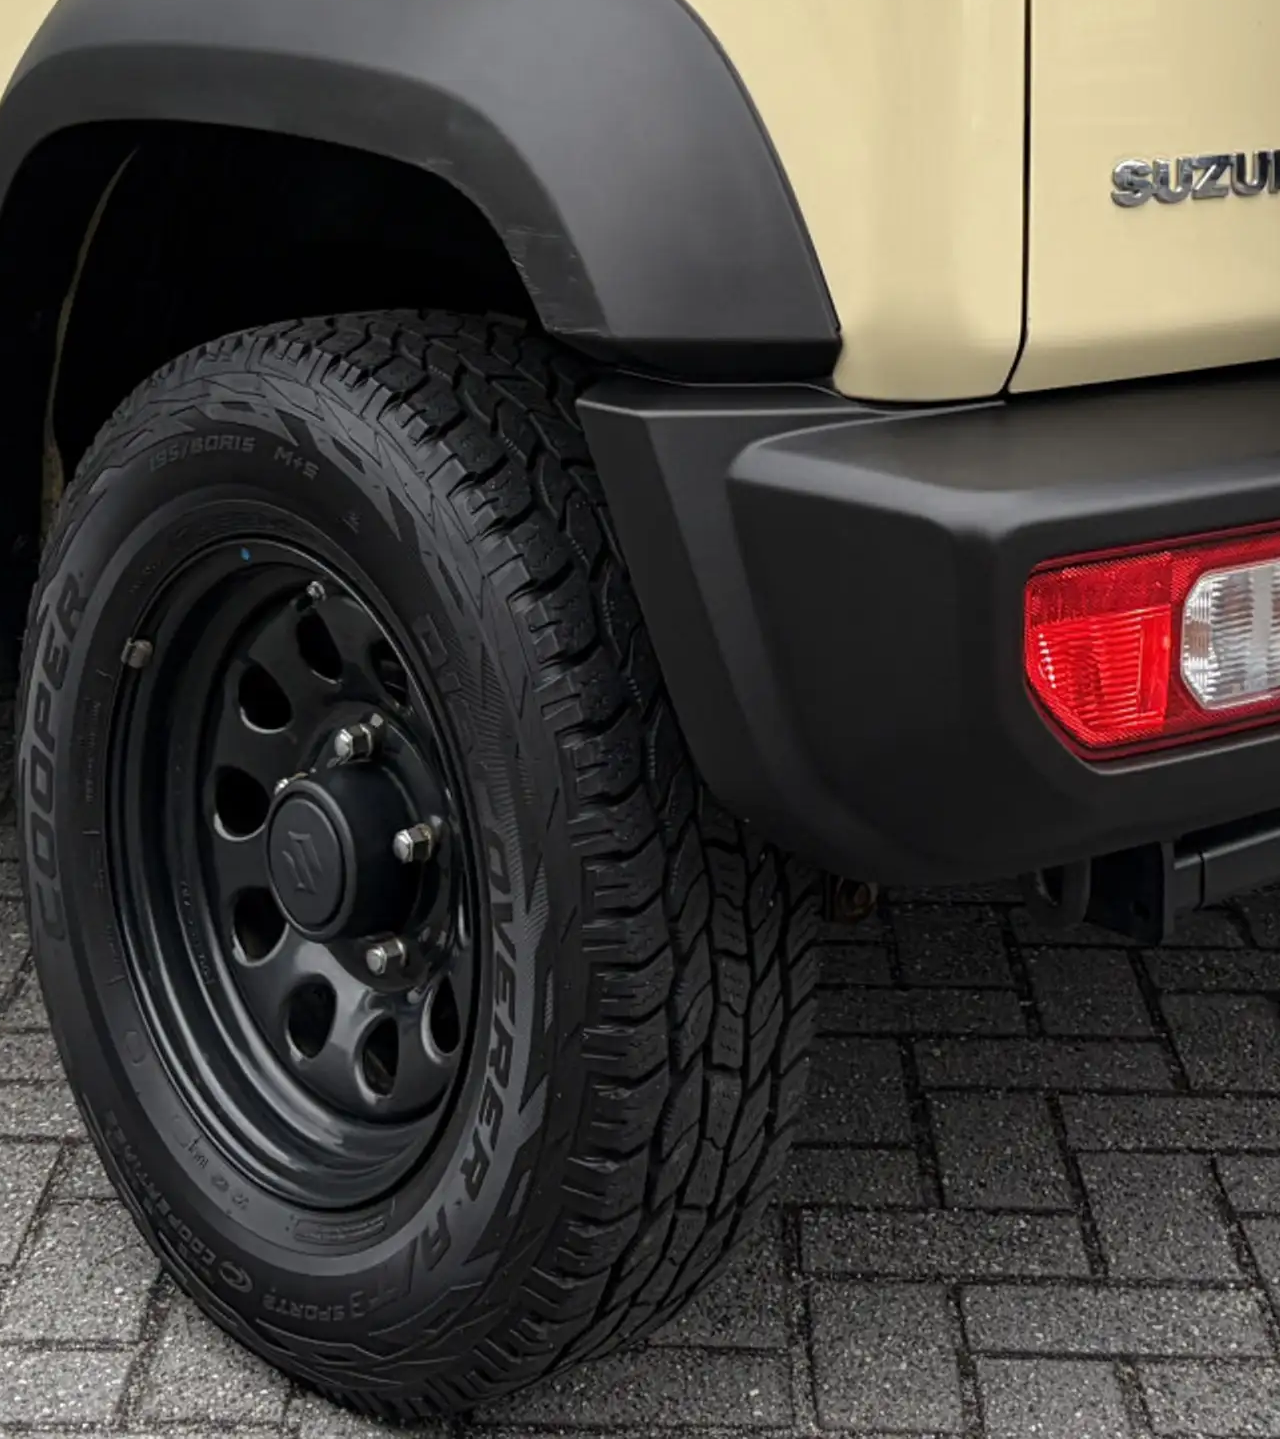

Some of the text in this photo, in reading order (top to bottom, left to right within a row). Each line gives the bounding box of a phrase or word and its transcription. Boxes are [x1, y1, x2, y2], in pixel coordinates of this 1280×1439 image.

[147, 433, 320, 481] 195/80R15 M+S
[24, 567, 87, 942] COOPER
